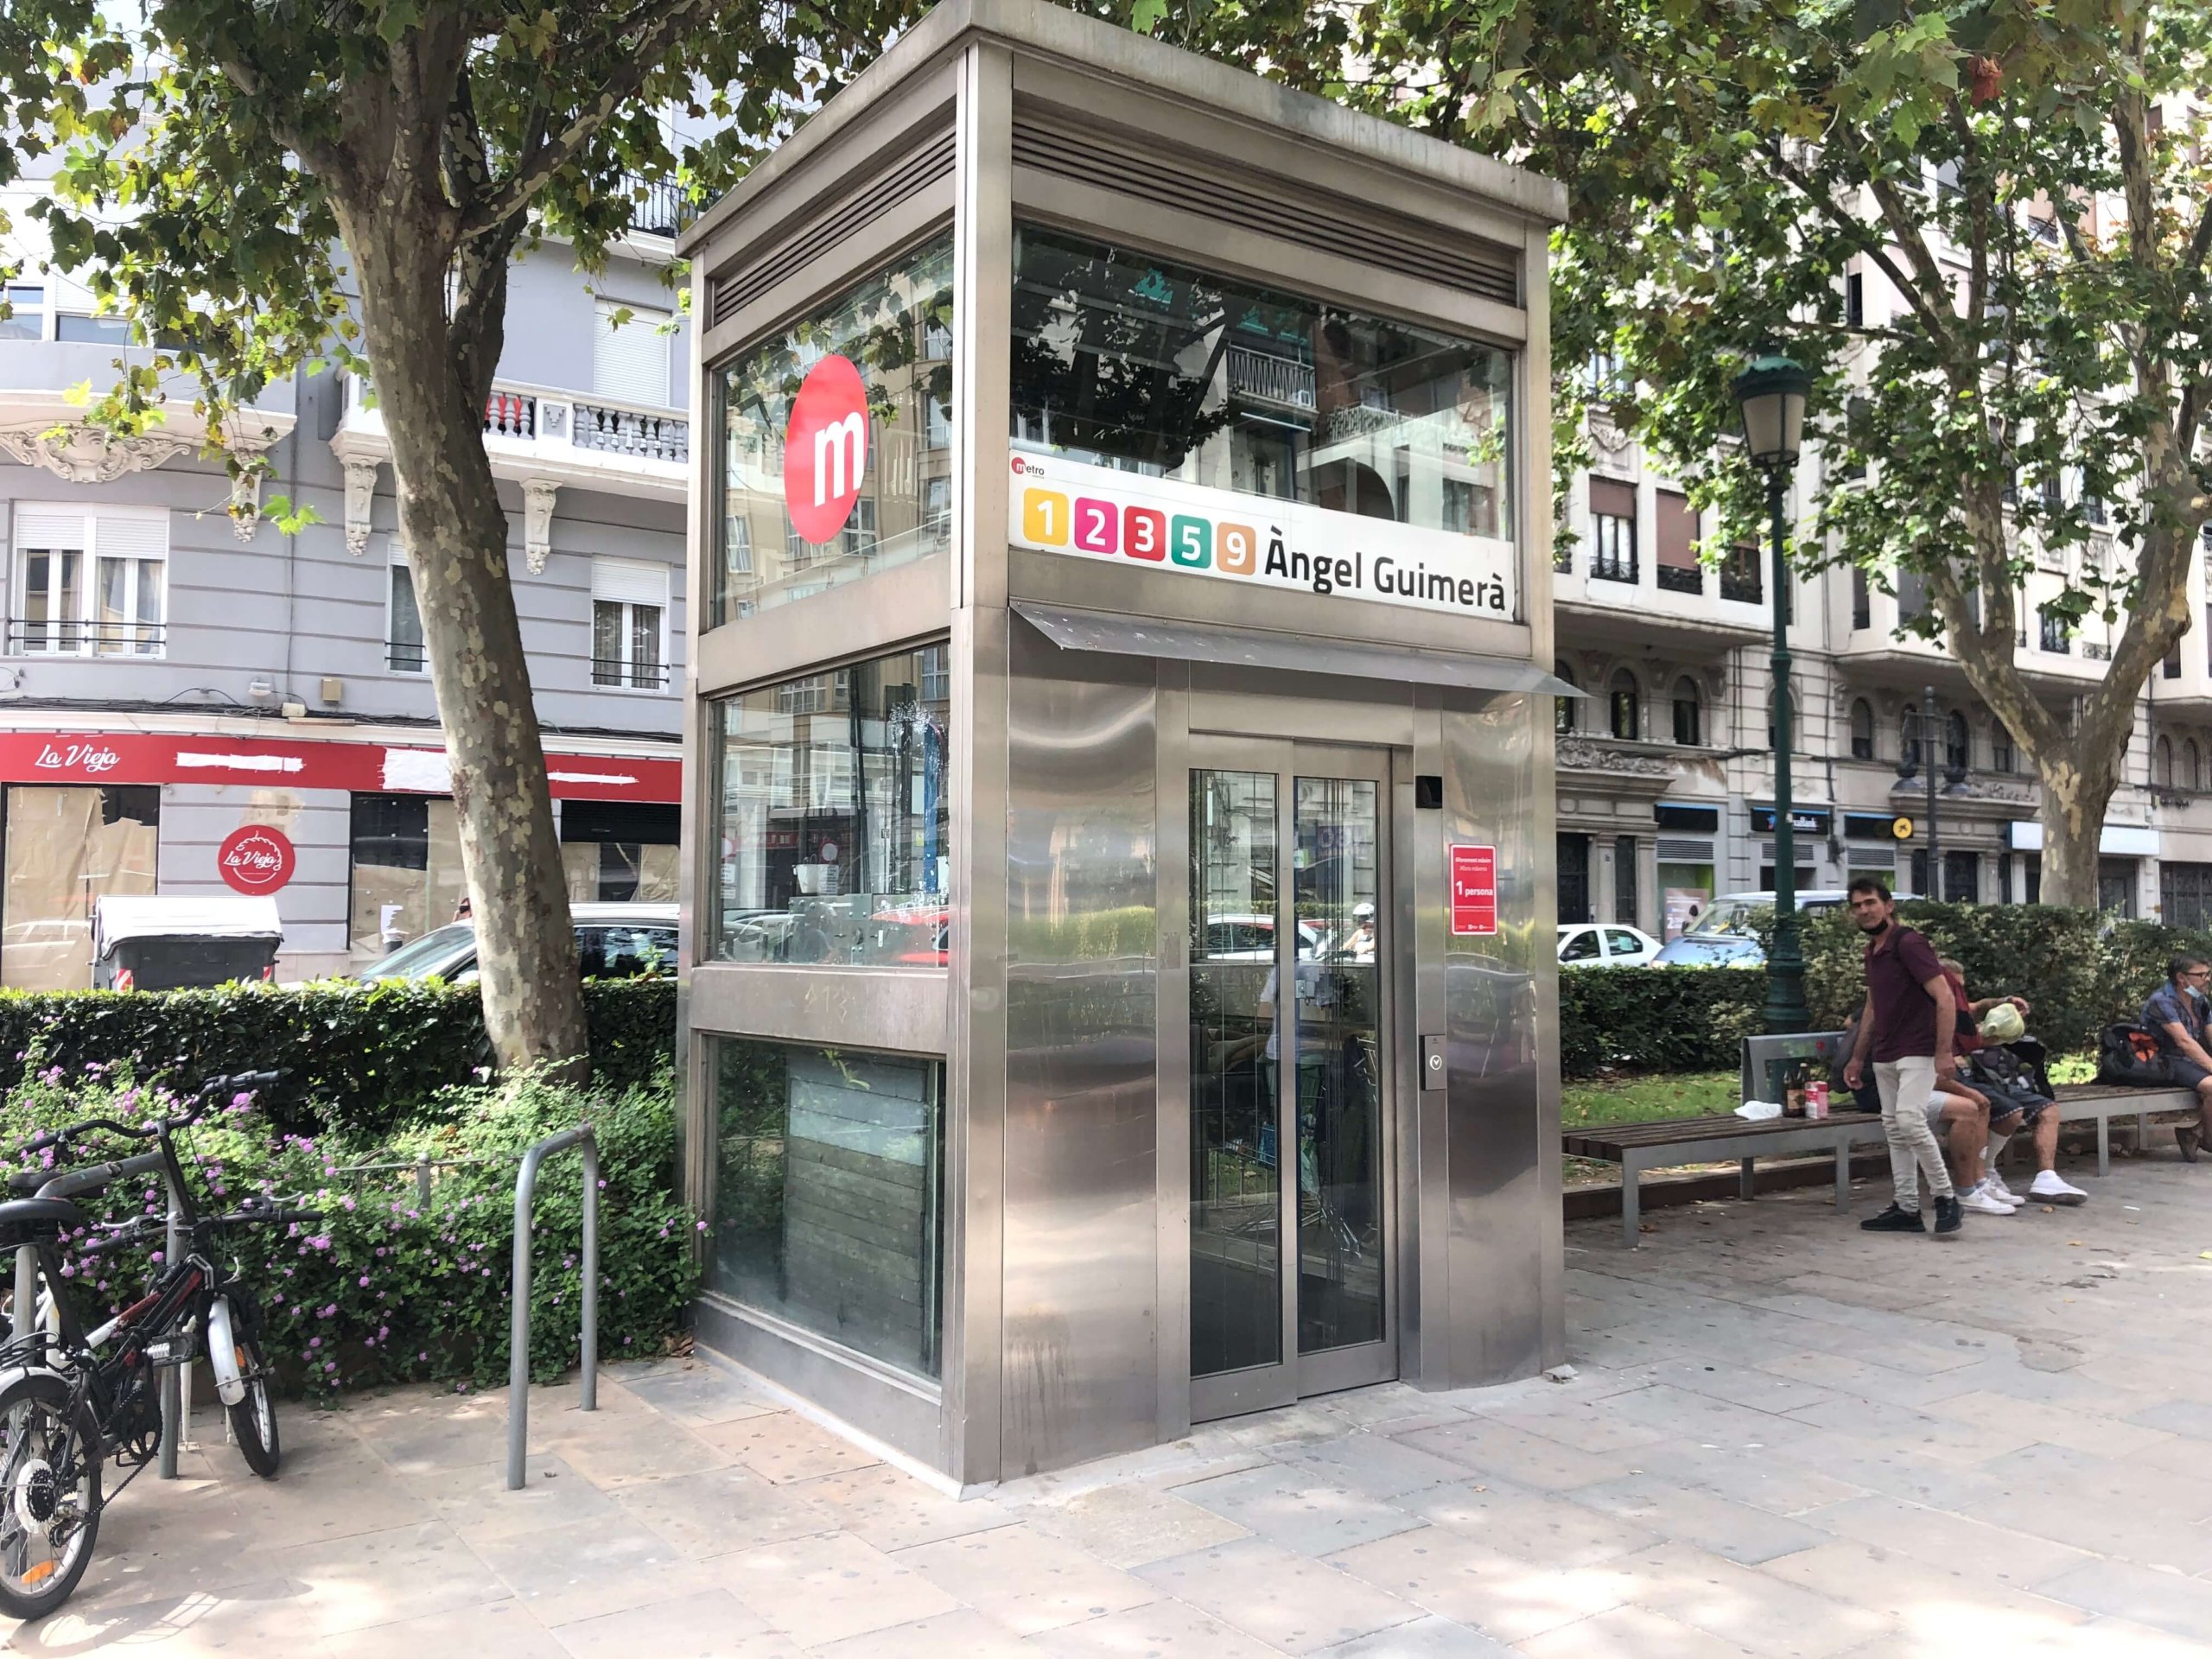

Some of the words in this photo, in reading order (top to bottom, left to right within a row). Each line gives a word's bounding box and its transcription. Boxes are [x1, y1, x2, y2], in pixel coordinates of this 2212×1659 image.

[814, 411, 864, 508] m
[1014, 461, 1045, 475] metro
[1037, 499, 1053, 537] 1
[1085, 508, 1106, 546] 2
[1135, 516, 1154, 552] 3
[1181, 524, 1201, 562] 5
[1226, 531, 1247, 567] 9
[1265, 524, 1362, 594] Àngel
[1374, 556, 1506, 611] Guimerà
[35, 744, 62, 768] La
[65, 744, 121, 772] Vieja
[223, 850, 242, 866] La
[242, 850, 276, 869] Vieja
[1456, 880, 1463, 896] 1
[1465, 888, 1494, 898] persona
